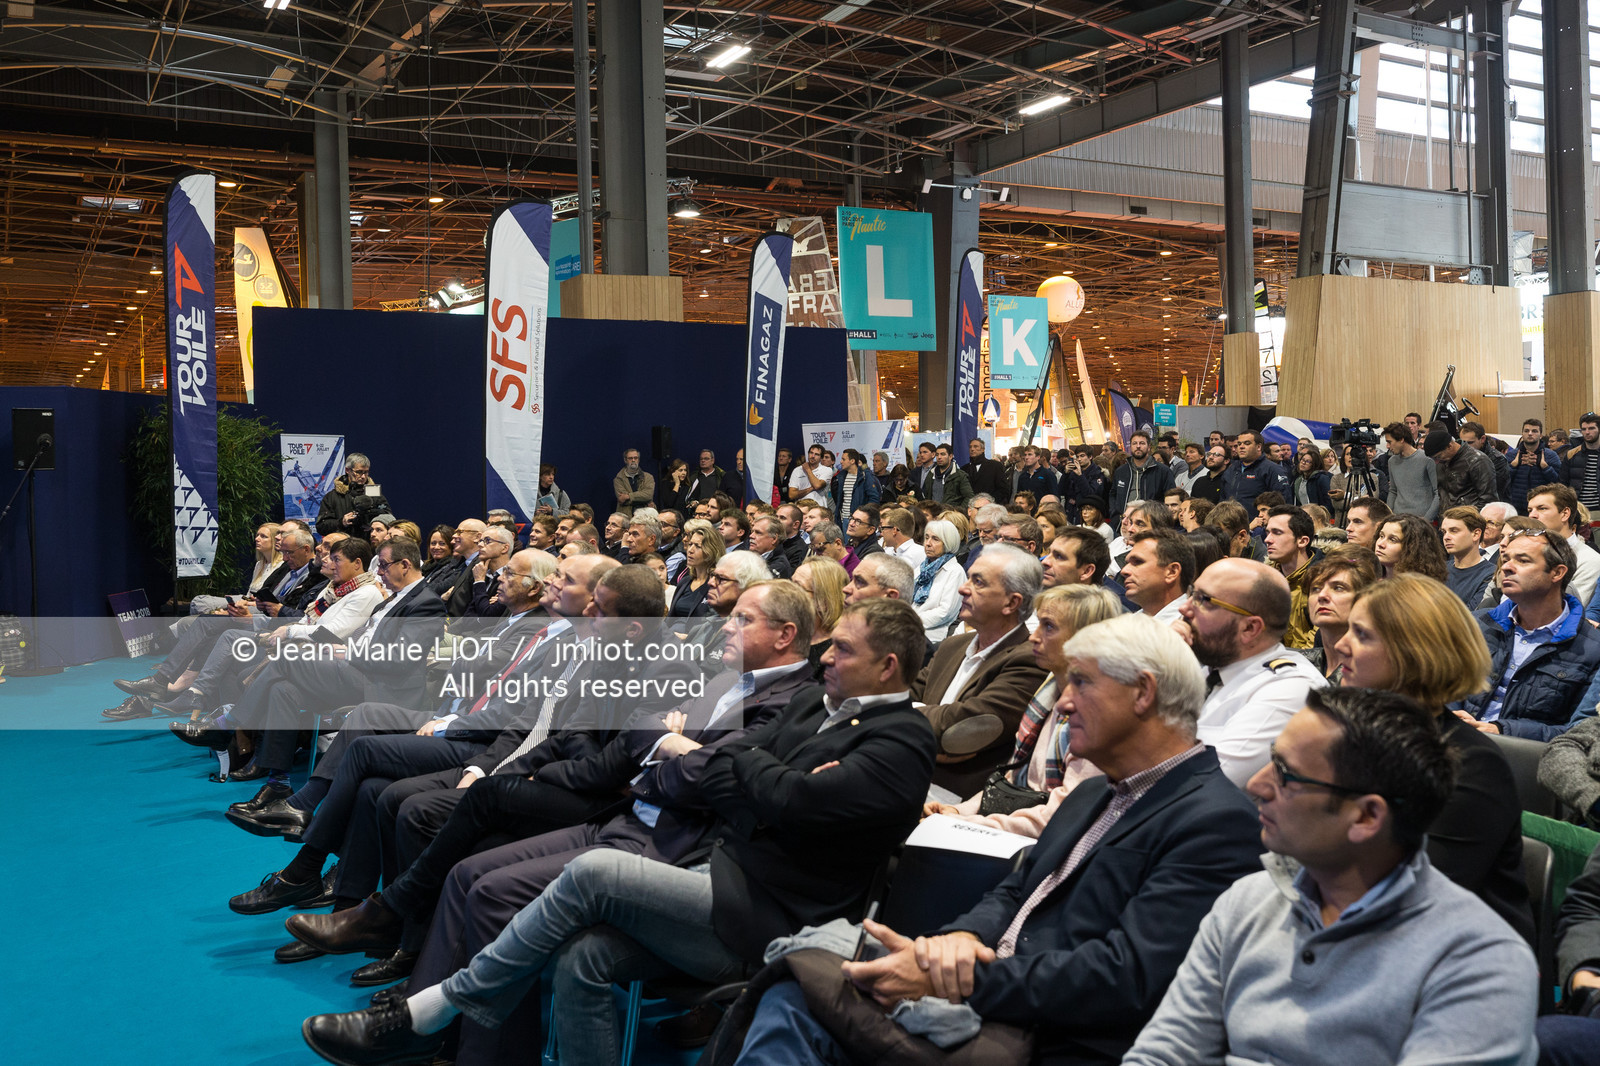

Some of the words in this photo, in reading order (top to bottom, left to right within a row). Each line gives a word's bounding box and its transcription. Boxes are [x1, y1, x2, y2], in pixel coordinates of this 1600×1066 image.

[848, 213, 887, 241] Nautic
[788, 294, 836, 315] FRA
[866, 245, 913, 317] L
[175, 314, 192, 416] TOUR
[191, 306, 207, 406] VOILE
[490, 298, 528, 410] SFS
[755, 305, 773, 404] FINAGAZ
[1002, 318, 1038, 366] K
[958, 350, 969, 422] TOUR
[966, 346, 976, 417] VOILE
[288, 443, 303, 451] TOUR
[117, 611, 137, 623] TEAM
[136, 607, 151, 619] 2018
